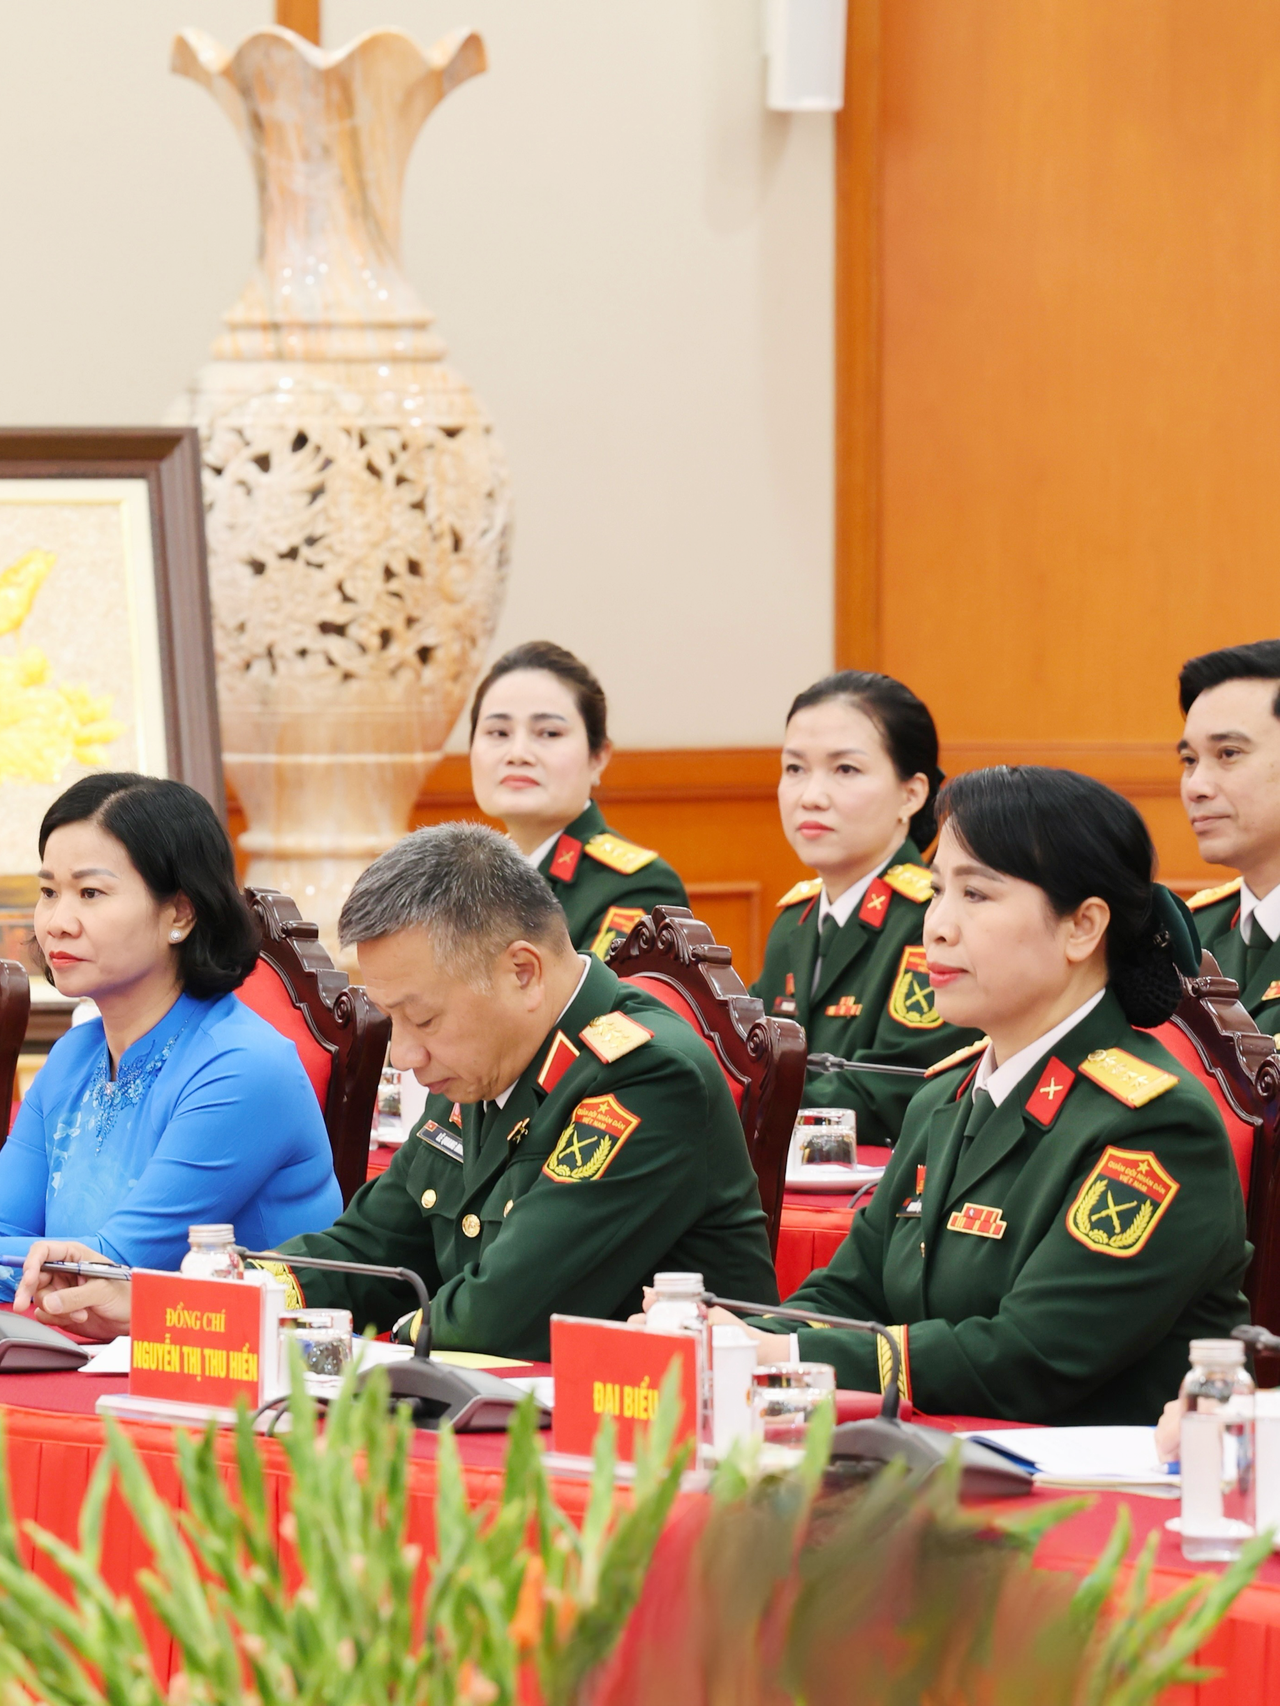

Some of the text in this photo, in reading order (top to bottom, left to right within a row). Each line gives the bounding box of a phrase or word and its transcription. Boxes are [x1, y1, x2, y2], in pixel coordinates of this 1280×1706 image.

[1132, 1179, 1148, 1193] NAM
[1152, 1182, 1166, 1195] DÂN
[165, 1301, 226, 1333] ĐỒNG CHÍ
[132, 1333, 180, 1373] NGUYỄN
[181, 1345, 202, 1382] THỊ
[203, 1347, 227, 1379] THU
